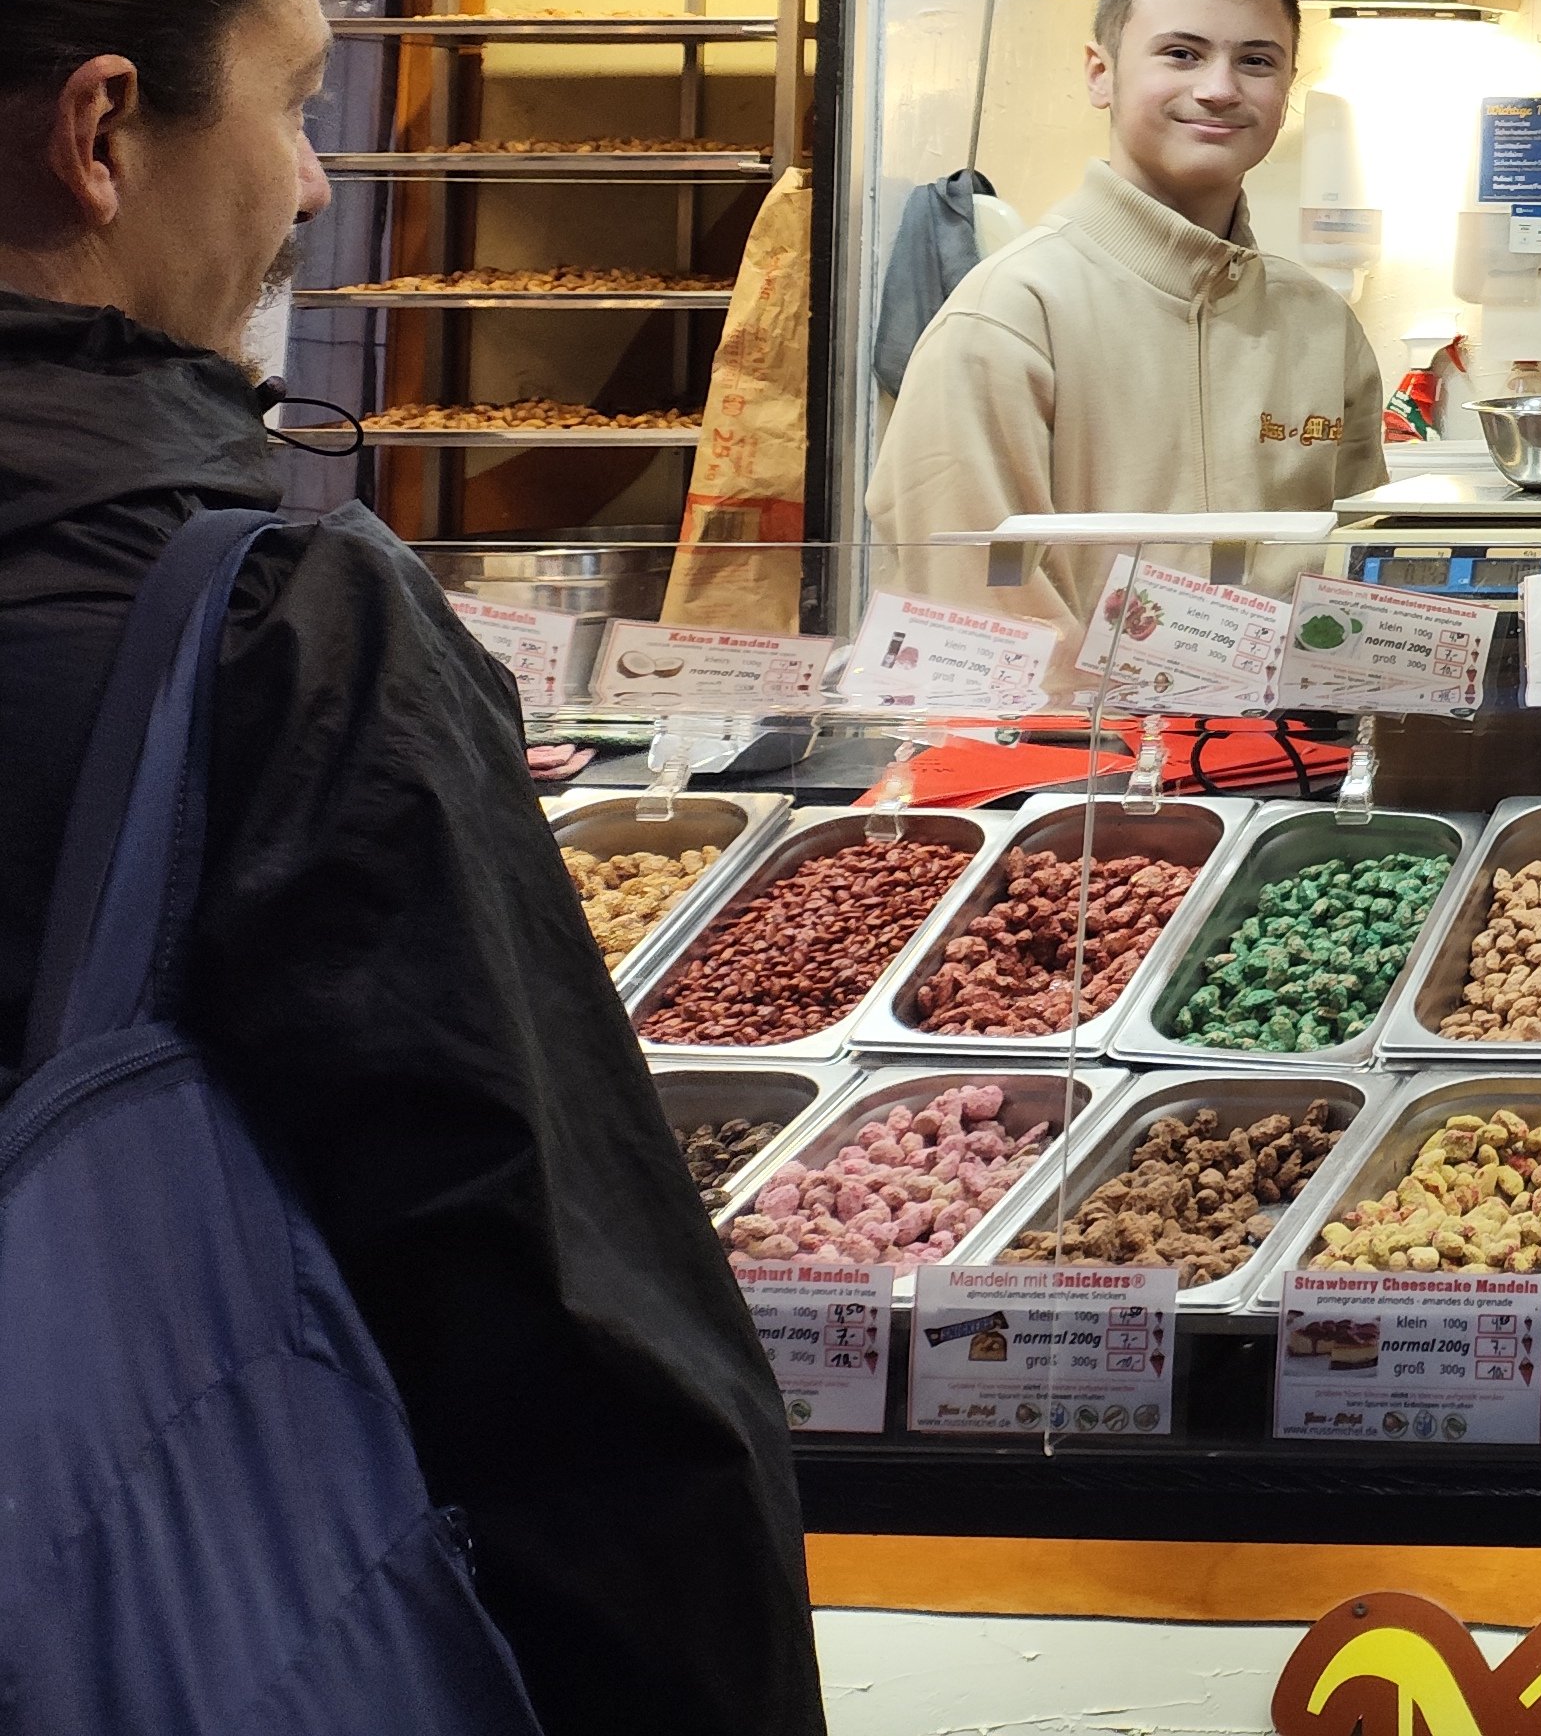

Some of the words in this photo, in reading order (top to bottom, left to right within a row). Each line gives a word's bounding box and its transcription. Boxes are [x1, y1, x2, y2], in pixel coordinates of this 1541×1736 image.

[1221, 588, 1277, 614] Mandeln
[949, 612, 988, 630] Baked
[949, 1272, 1017, 1288] Mandeln
[1022, 1273, 1049, 1288] mit
[1294, 1277, 1378, 1293] Strawberry
[1383, 1278, 1471, 1292] Cheesecake
[1476, 1279, 1538, 1294] Mandeln
